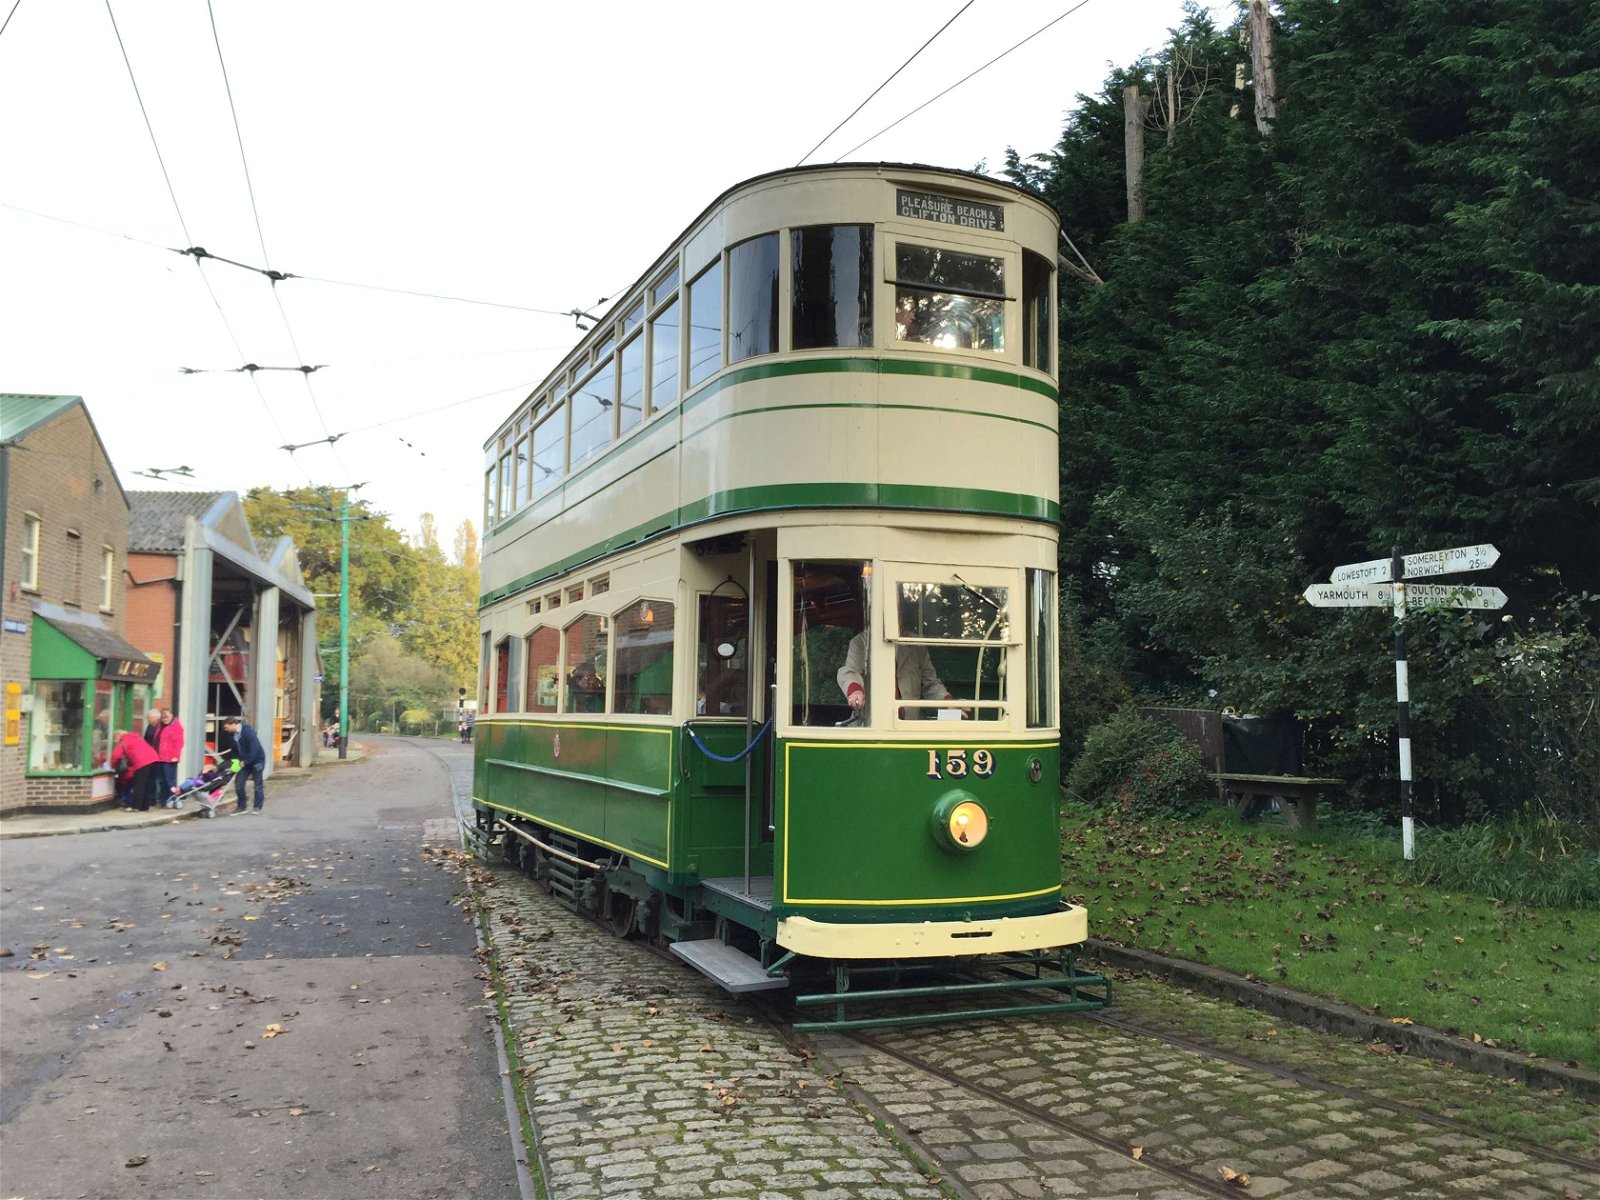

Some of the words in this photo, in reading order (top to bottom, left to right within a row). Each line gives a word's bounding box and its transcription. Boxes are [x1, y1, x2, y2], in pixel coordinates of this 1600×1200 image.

[901, 195, 954, 214] PLEASURE
[957, 205, 987, 219] BEACH
[988, 210, 996, 220] &
[902, 206, 956, 224] CLIFTON
[960, 216, 996, 230] DRIVE
[1408, 549, 1467, 565] SOMERLEYTON
[1337, 567, 1377, 581] LOWESTOFT
[1382, 567, 1387, 575] 2
[1408, 564, 1444, 576] NORWICH
[1318, 591, 1369, 600] YARMOUTH
[1411, 585, 1447, 596] OULTON
[926, 749, 996, 780] 159
